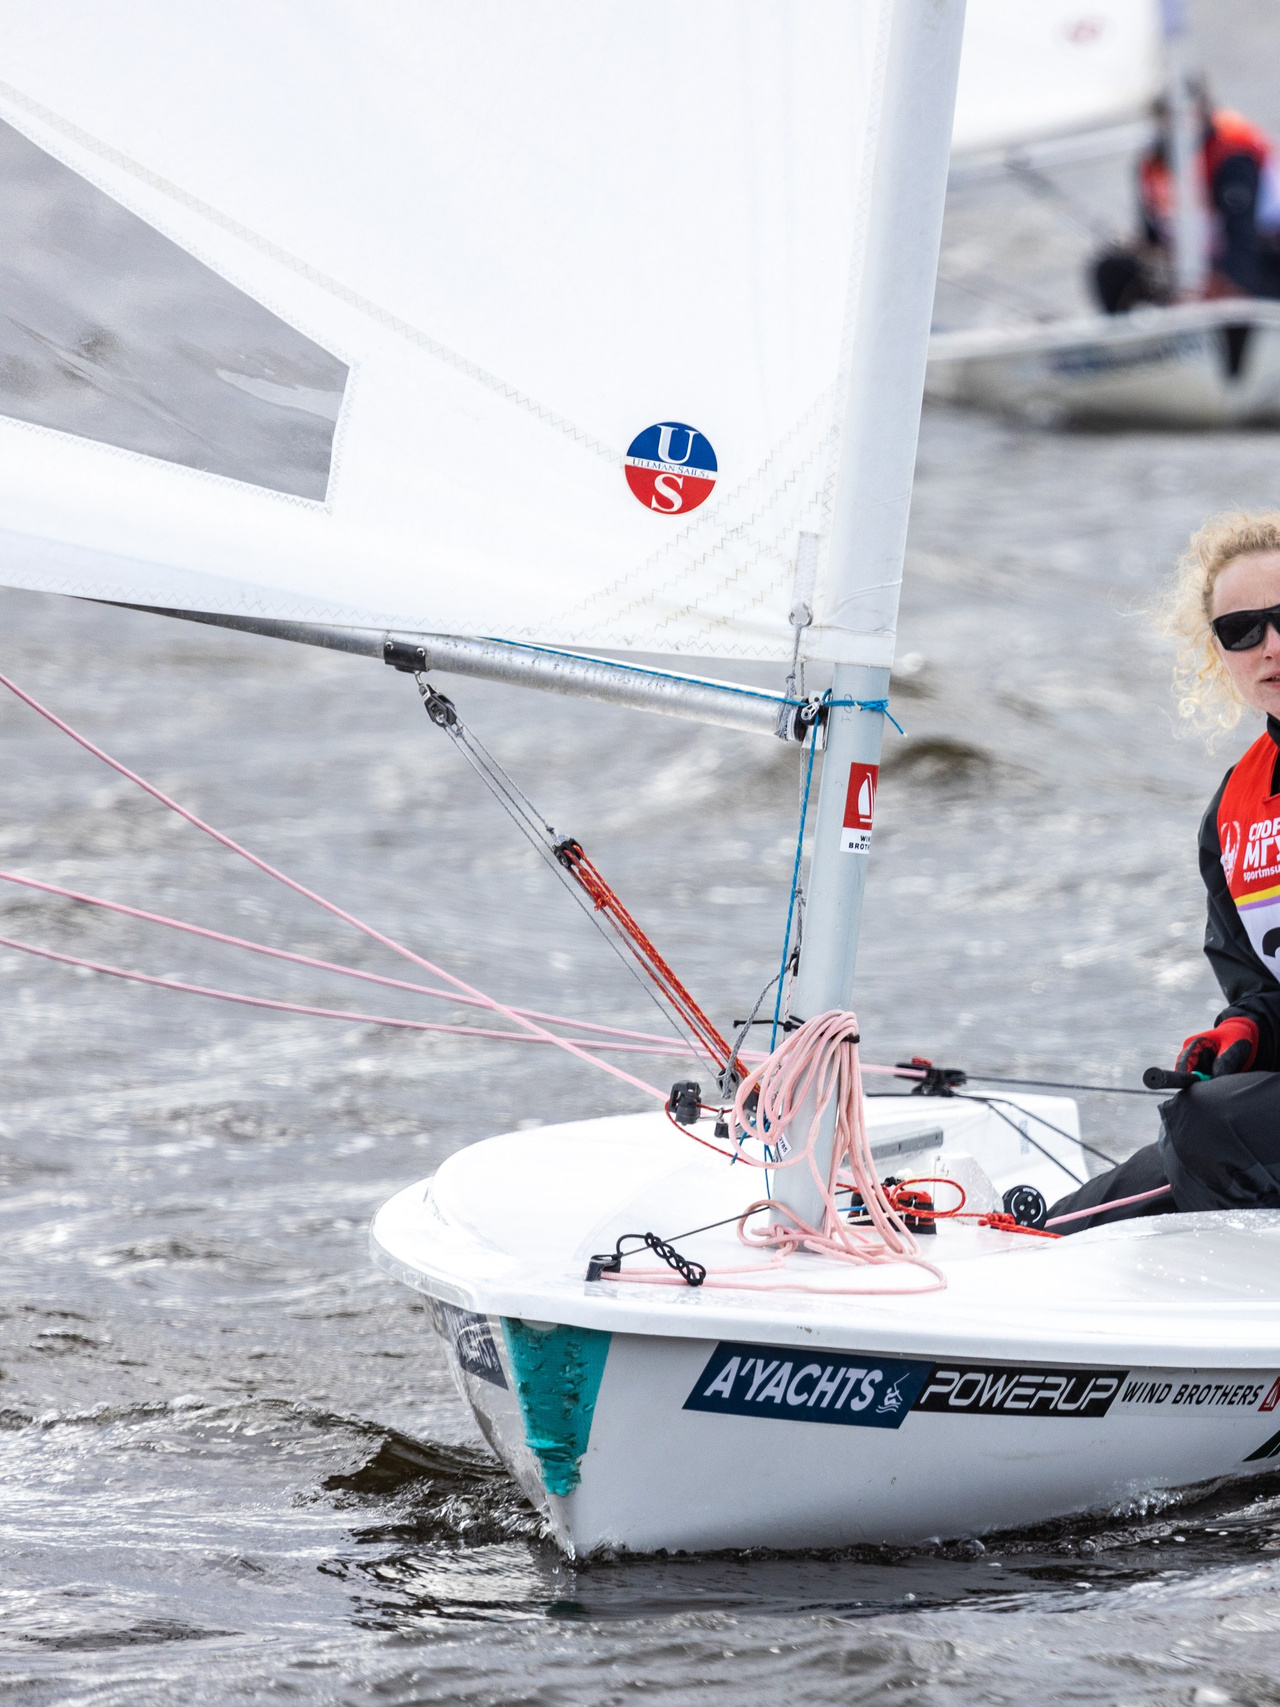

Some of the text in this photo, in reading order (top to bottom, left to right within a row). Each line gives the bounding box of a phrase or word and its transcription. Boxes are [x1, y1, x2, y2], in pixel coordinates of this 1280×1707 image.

[656, 424, 700, 464] U
[632, 458, 706, 478] ULLMAN SAILS
[650, 473, 684, 512] S
[703, 1356, 883, 1412] A'YACHTS
[920, 1371, 1119, 1411] POWERUP
[1121, 1381, 1265, 1406] WIND BROTHERS
